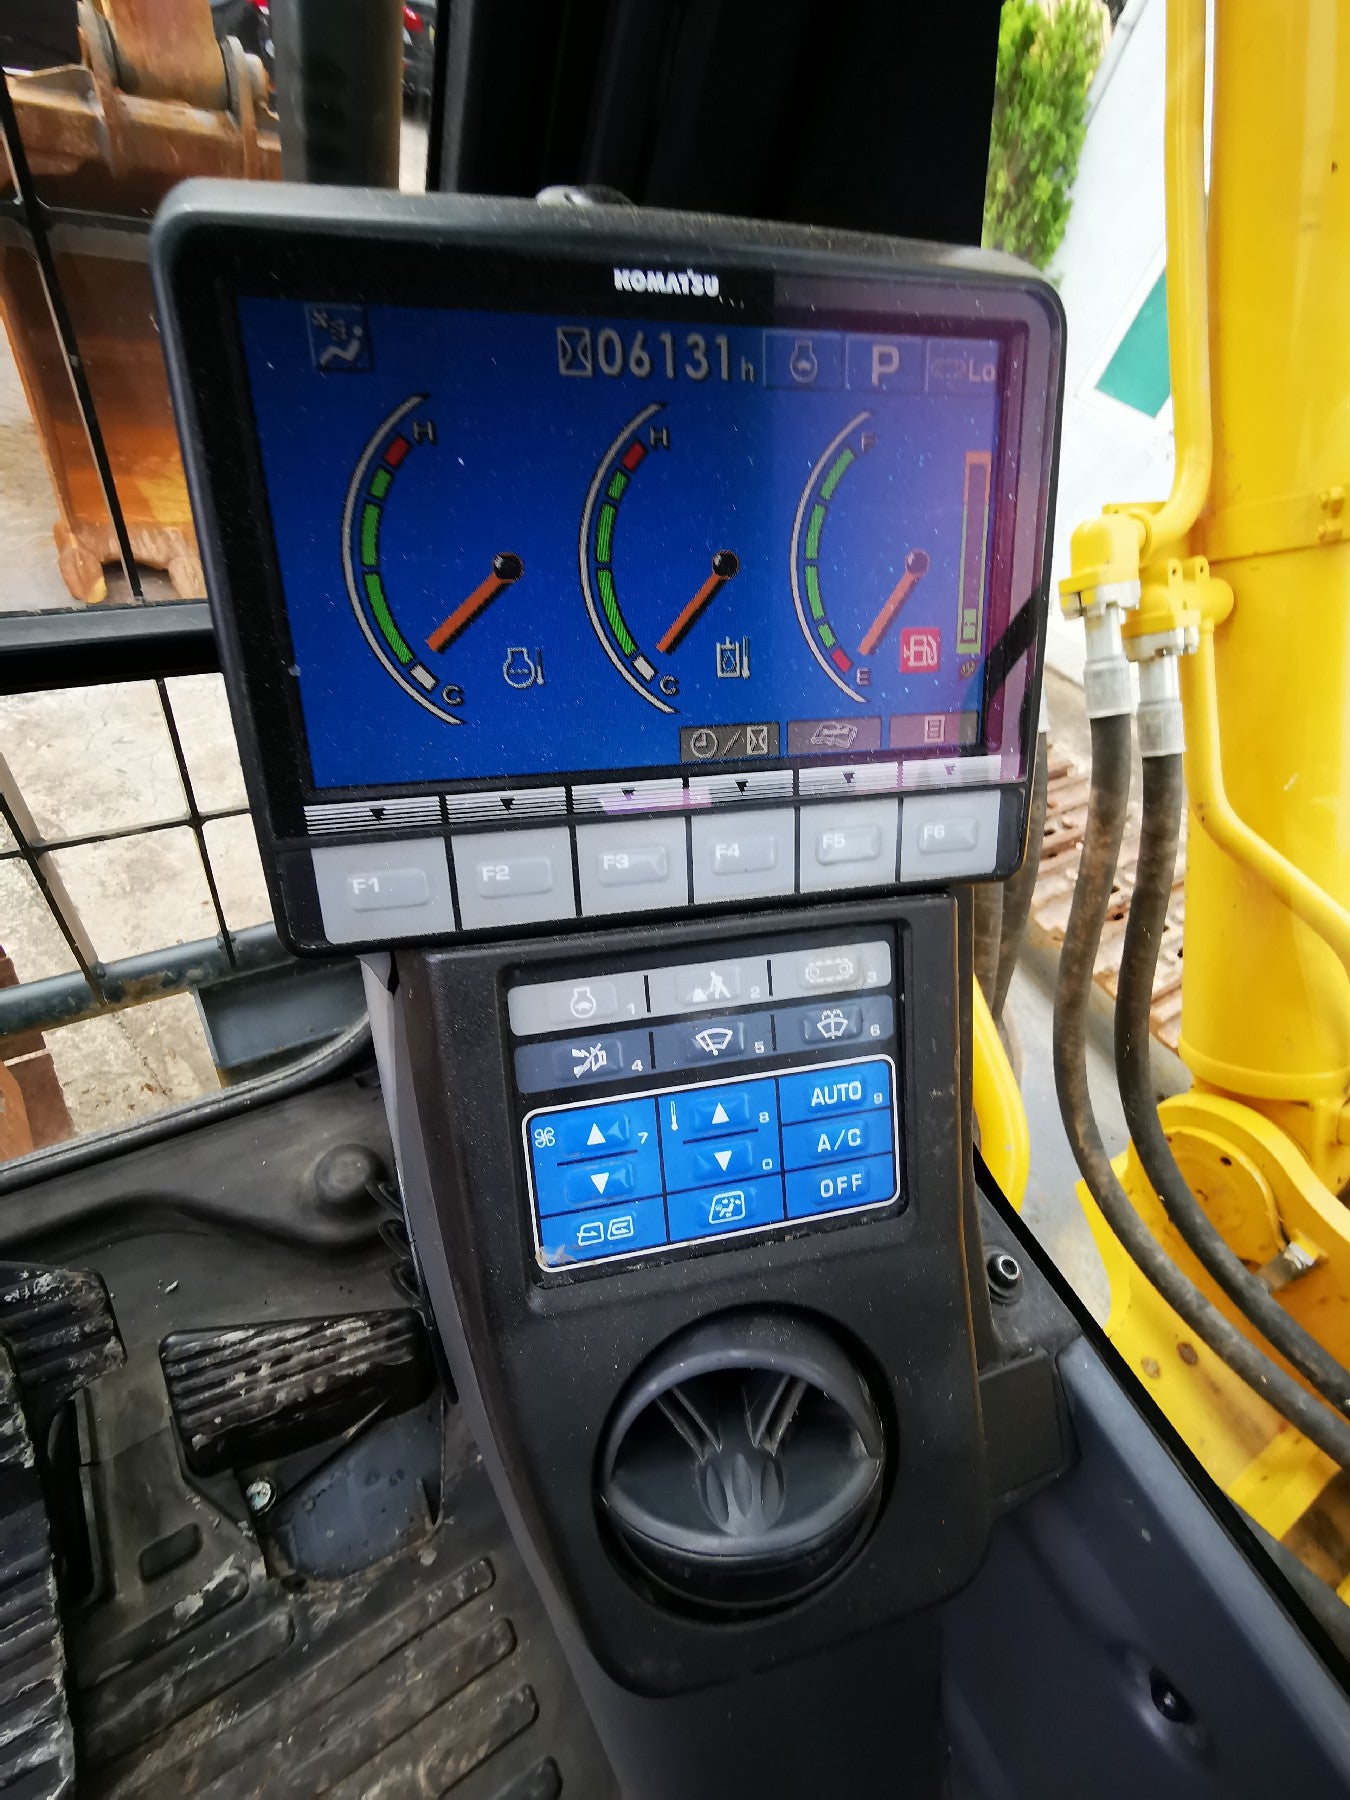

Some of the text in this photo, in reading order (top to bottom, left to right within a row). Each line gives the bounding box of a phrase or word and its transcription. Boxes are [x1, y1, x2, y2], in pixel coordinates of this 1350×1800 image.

[613, 268, 719, 297] KOMATSU
[871, 344, 899, 386] P
[969, 358, 996, 382] Lo
[412, 419, 434, 442] H
[650, 426, 668, 448] H
[660, 675, 677, 695] C
[856, 667, 870, 686] E
[442, 685, 462, 705] C
[923, 824, 946, 840] F6
[822, 833, 846, 849] F5
[715, 843, 740, 860] F4
[603, 853, 630, 870] F3
[481, 865, 511, 882] F2
[351, 877, 380, 895] F1
[867, 970, 878, 983] 3
[750, 985, 761, 998] 2
[627, 1002, 636, 1015] 1
[870, 1023, 881, 1037] 6
[754, 1040, 765, 1054] 5
[631, 1059, 643, 1072] 4
[811, 1081, 862, 1108] AUTO
[873, 1092, 883, 1105] 9
[759, 1111, 770, 1124] 8
[637, 1131, 649, 1145] 7
[817, 1128, 861, 1153] A/C
[820, 1173, 863, 1199] OFF
